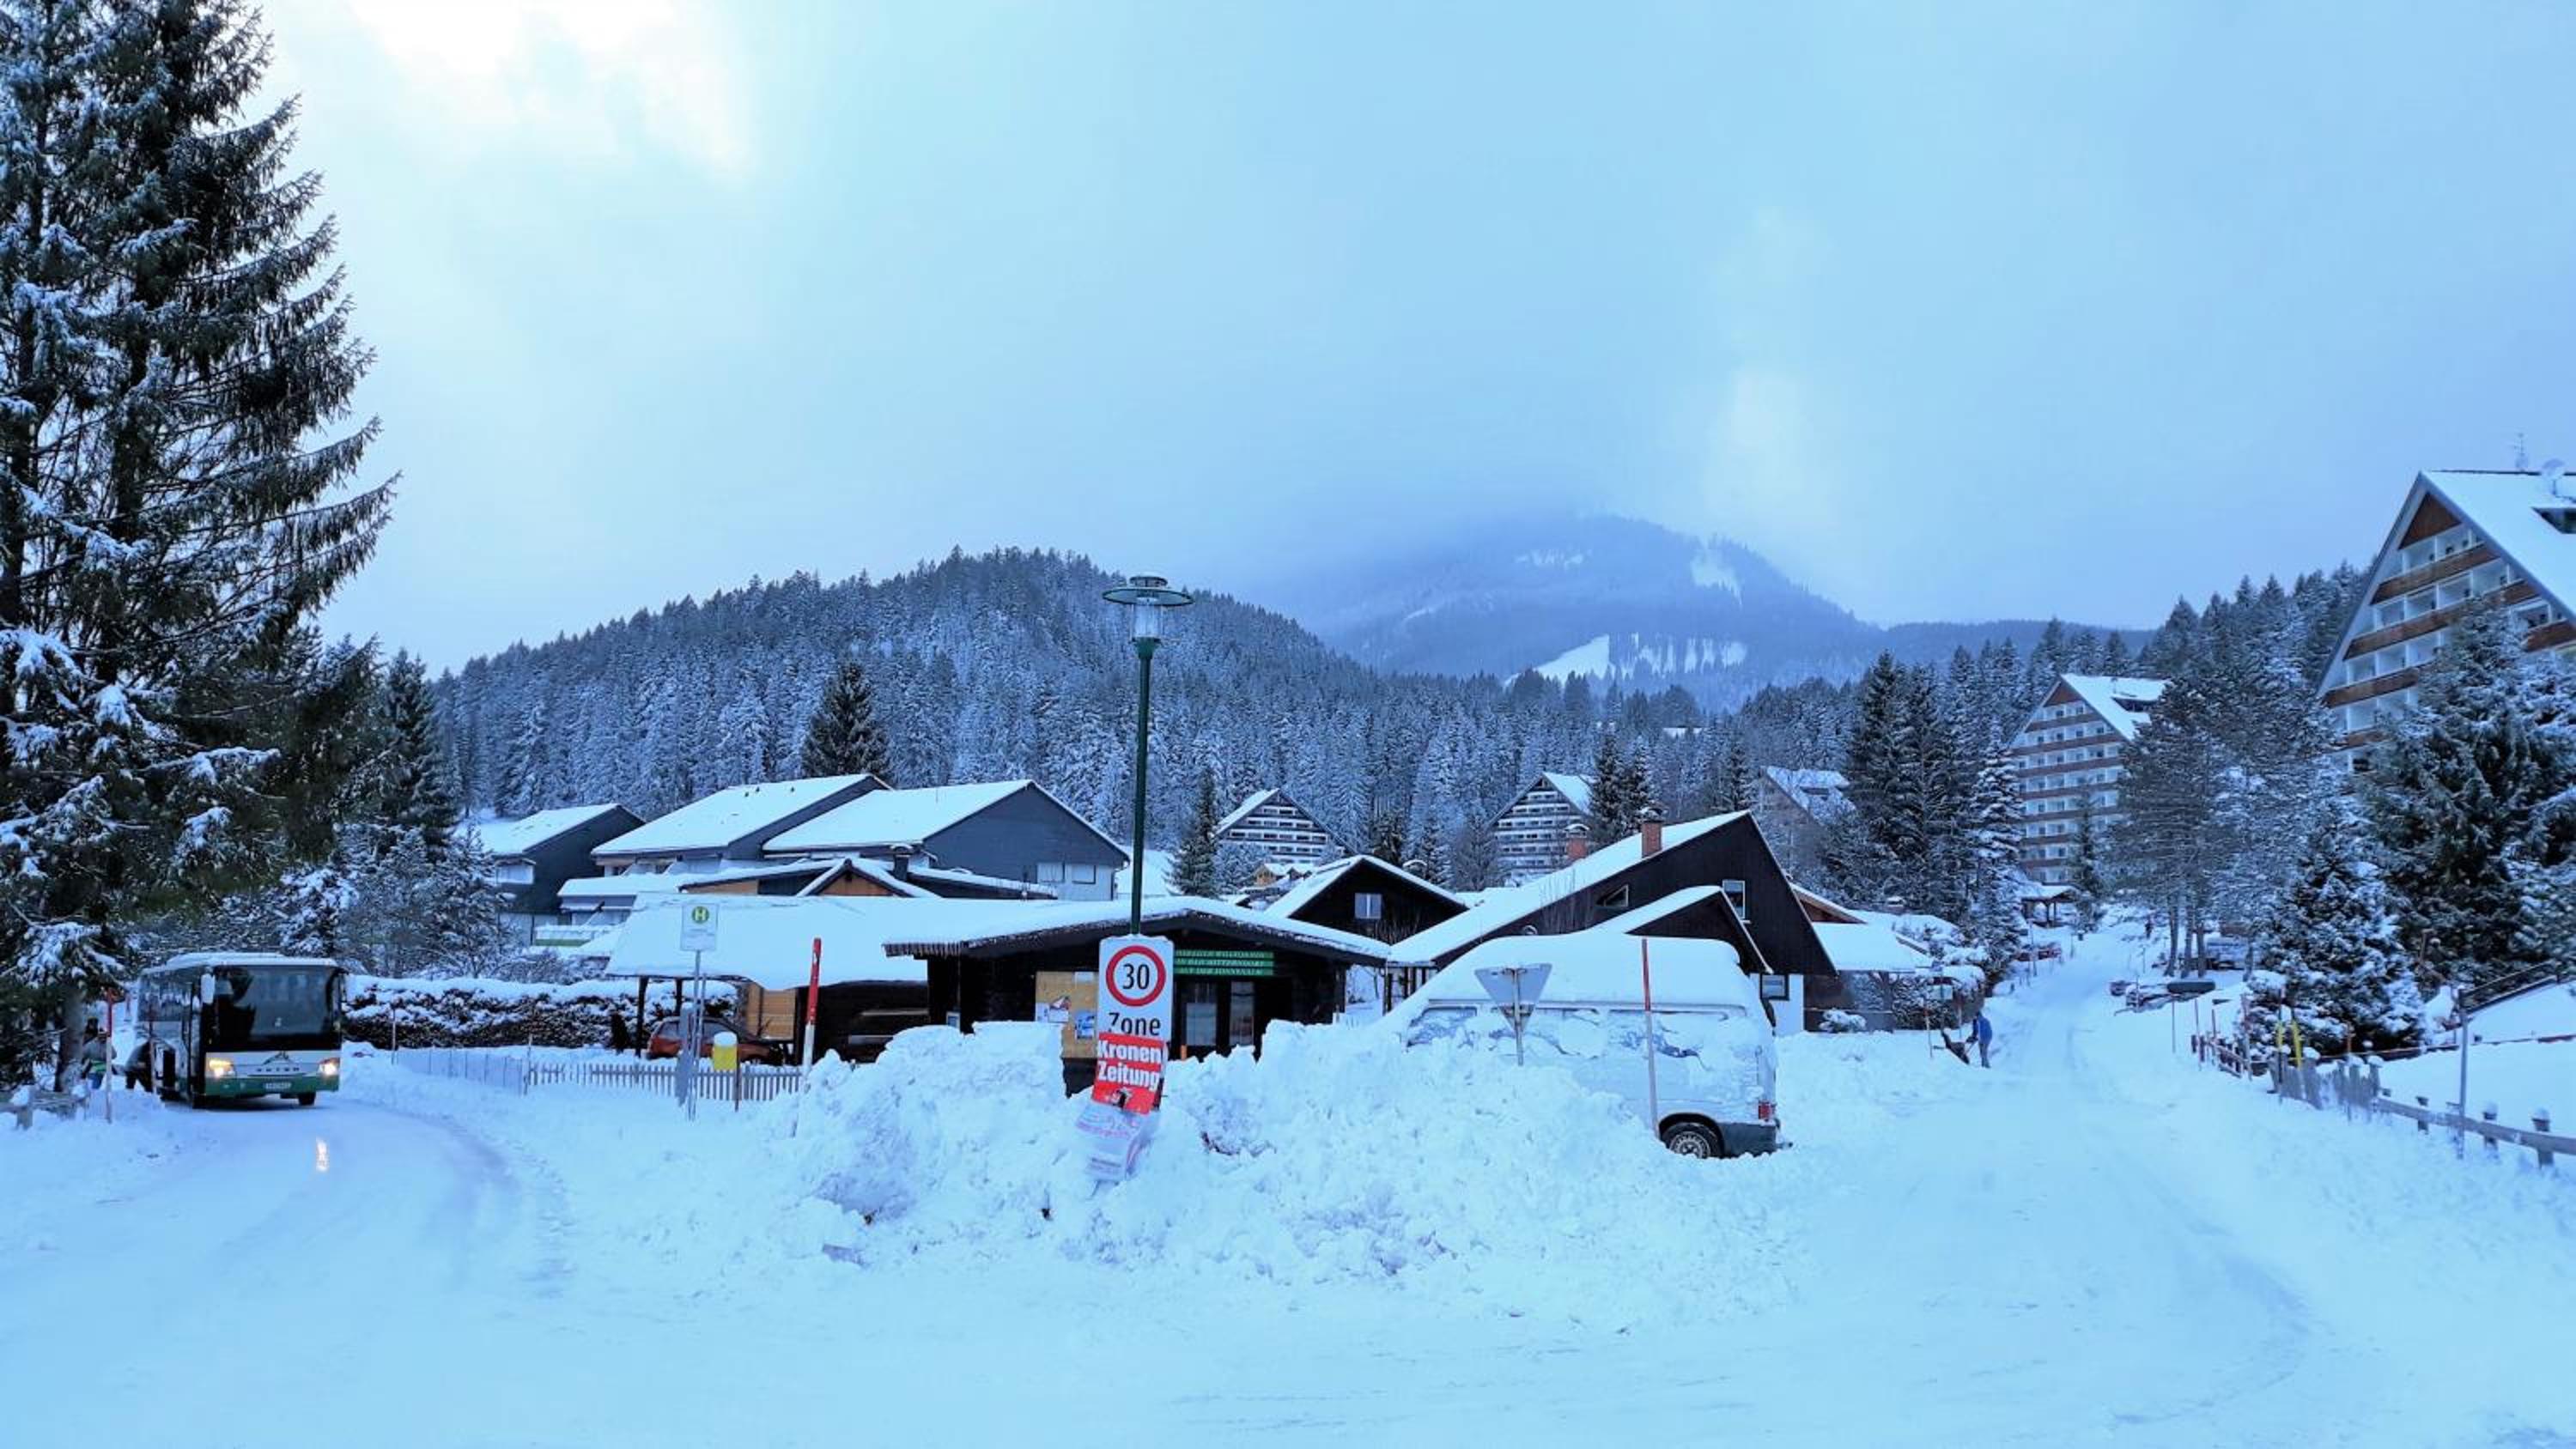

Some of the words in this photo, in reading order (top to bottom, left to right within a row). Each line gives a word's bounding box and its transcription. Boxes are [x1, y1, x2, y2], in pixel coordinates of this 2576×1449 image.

[695, 908, 707, 921] H
[1122, 963, 1151, 991] 30
[1108, 1012, 1162, 1036] Zone
[1098, 1040, 1162, 1064] Kronen
[1097, 1060, 1159, 1091] Zeitung
